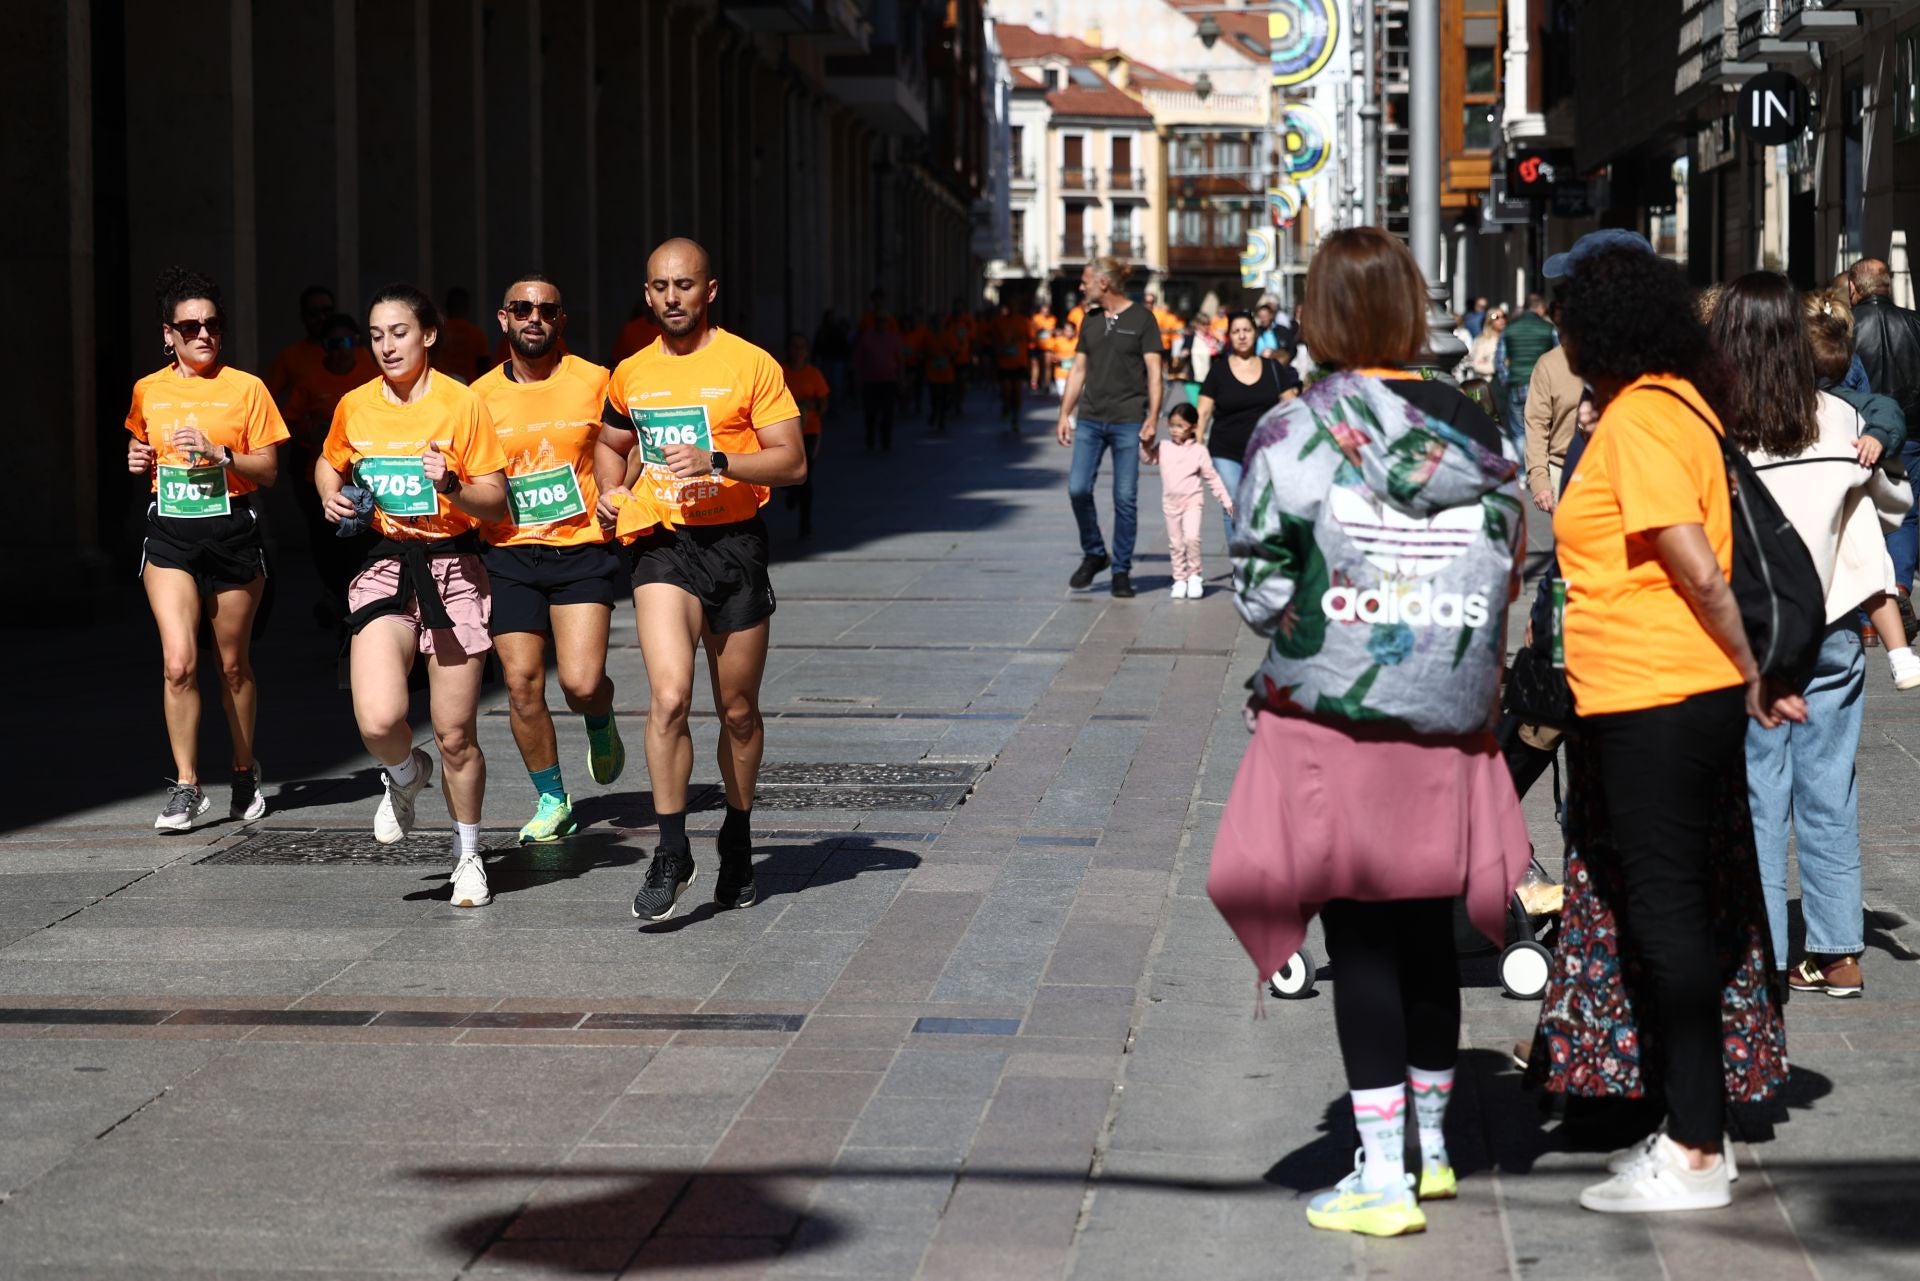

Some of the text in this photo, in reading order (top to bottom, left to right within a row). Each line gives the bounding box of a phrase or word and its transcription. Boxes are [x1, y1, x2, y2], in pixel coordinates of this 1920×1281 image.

[1752, 89, 1797, 128] IN
[641, 424, 698, 446] 3706
[166, 481, 214, 501] 1707
[515, 484, 568, 508] 1708
[655, 485, 719, 502] CÁNCER
[1321, 579, 1489, 628] adidas
